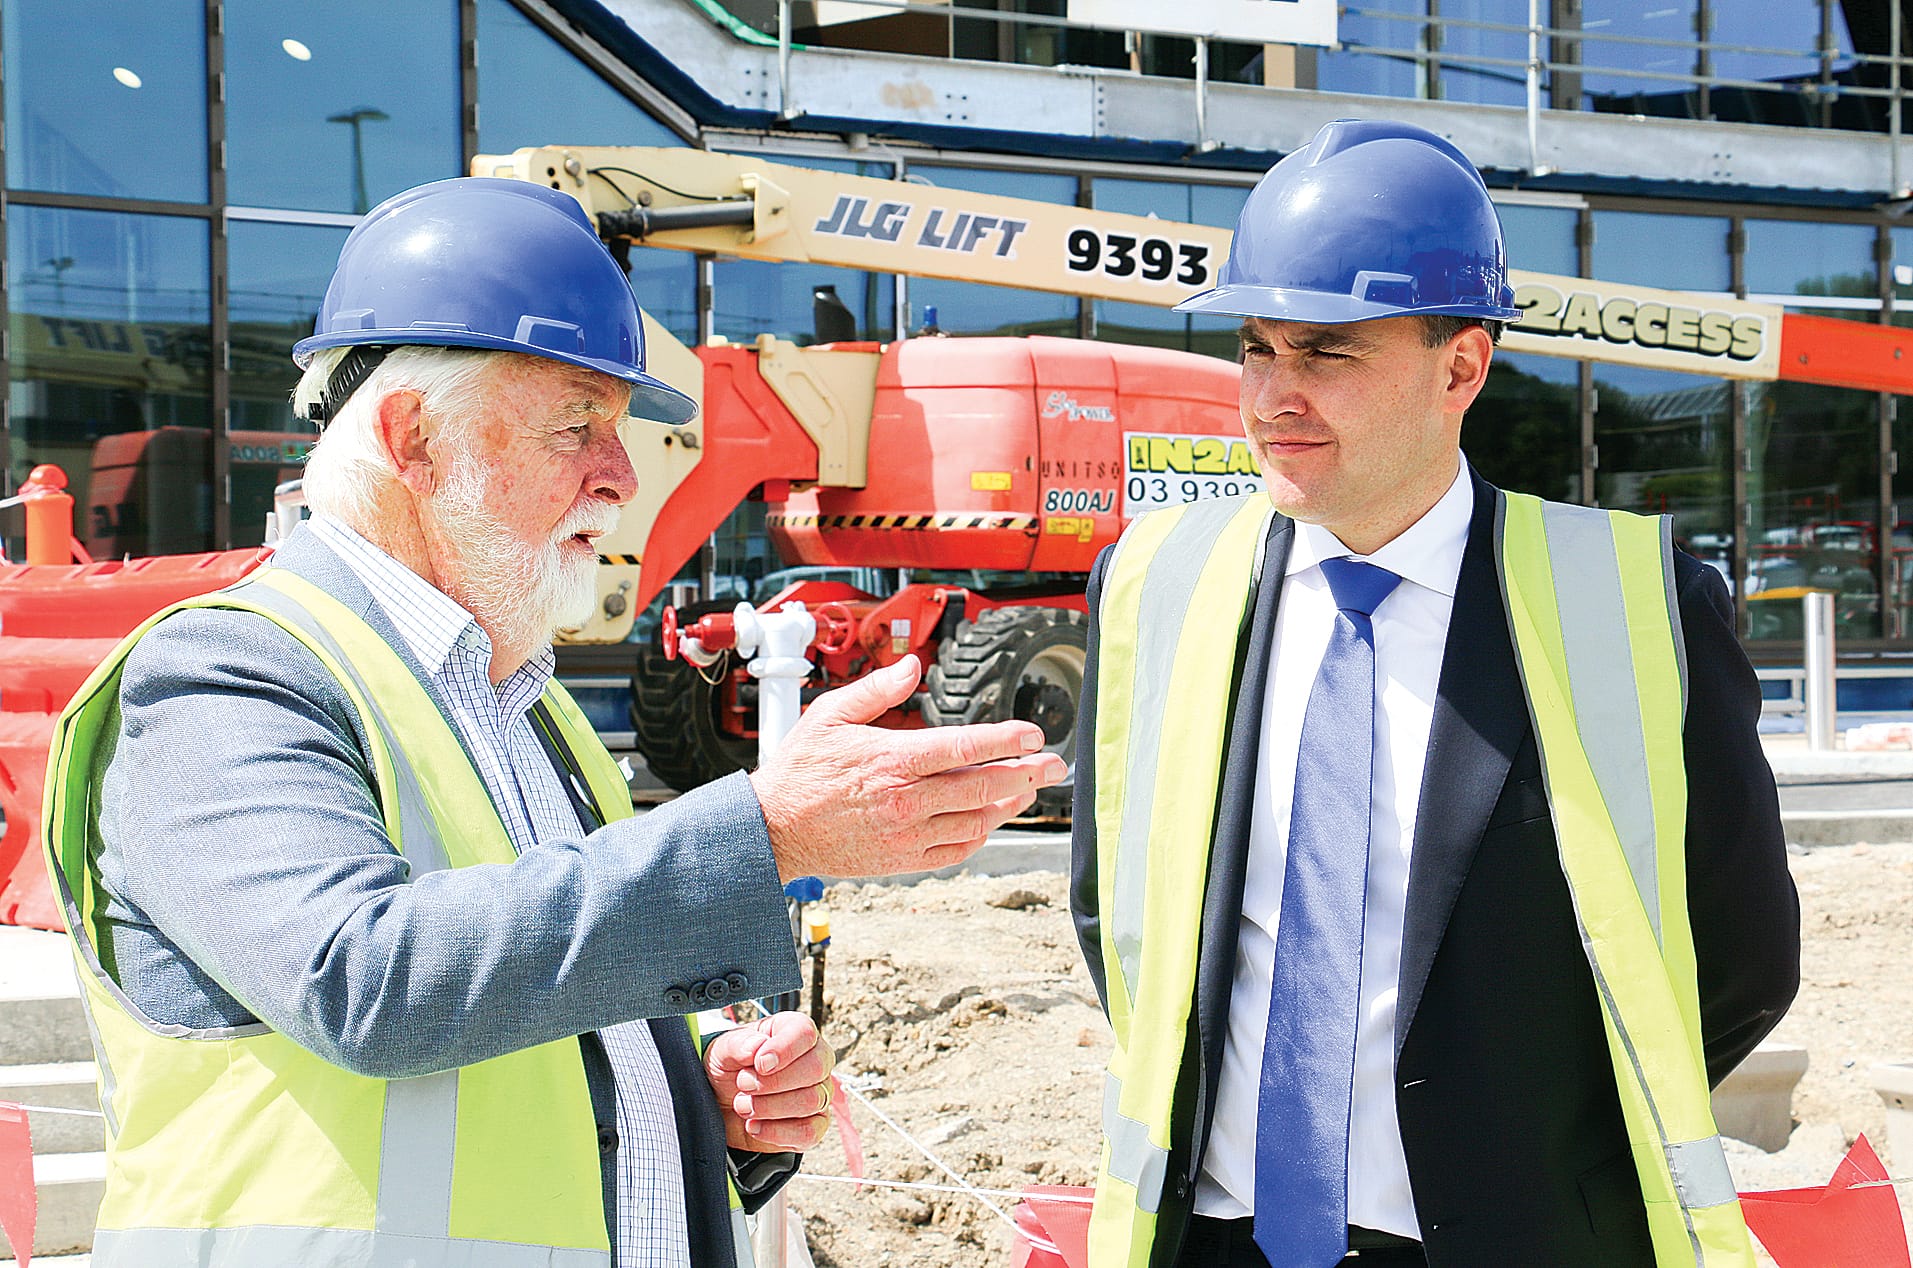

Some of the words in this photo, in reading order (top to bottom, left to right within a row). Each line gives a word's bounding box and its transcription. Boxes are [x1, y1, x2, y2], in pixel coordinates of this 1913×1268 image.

[814, 196, 910, 243] JLG
[917, 208, 1027, 257] LIFT
[1067, 229, 1209, 286] 9393
[1045, 490, 1114, 512] 800AJ
[1128, 477, 1168, 503] 03
